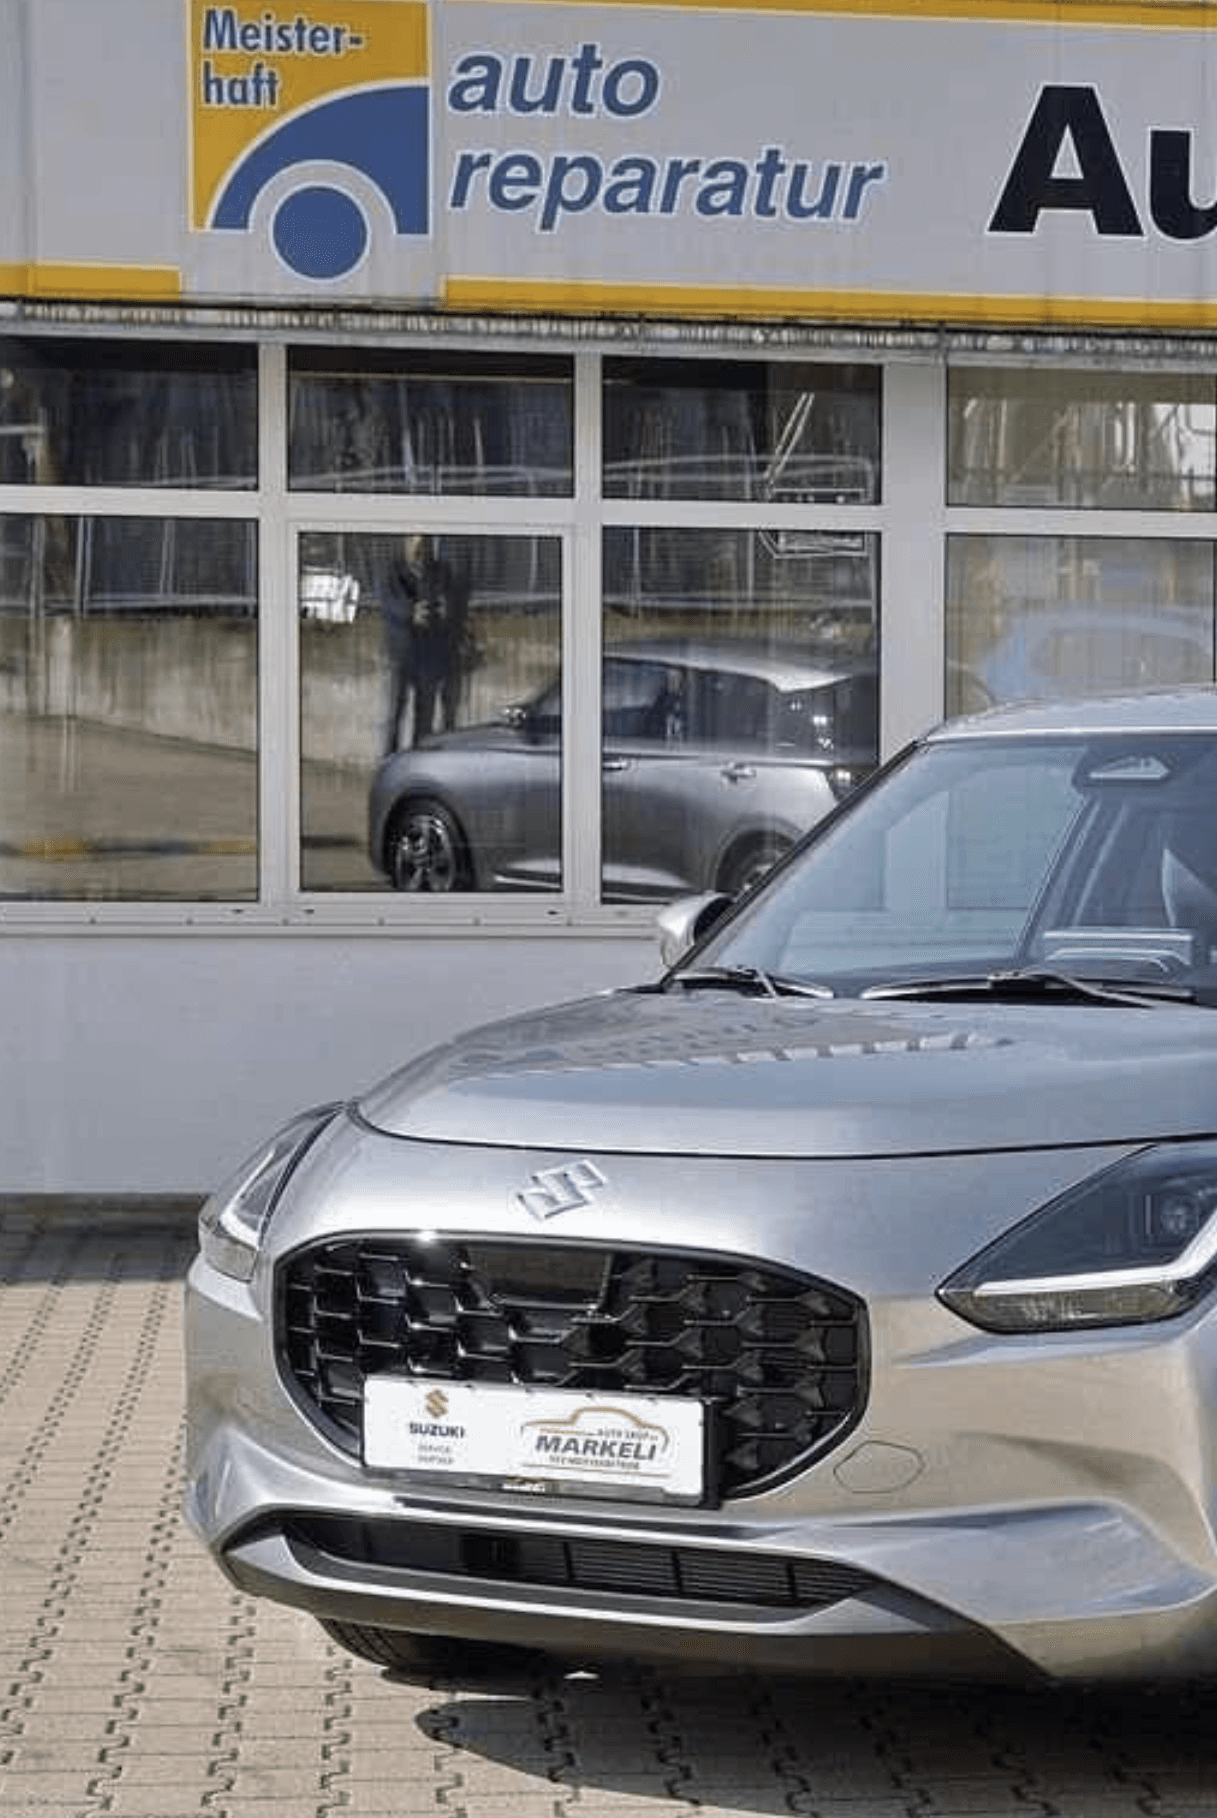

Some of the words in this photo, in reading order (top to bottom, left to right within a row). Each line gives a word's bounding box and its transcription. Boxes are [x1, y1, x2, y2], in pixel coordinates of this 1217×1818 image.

[203, 9, 362, 54] Meister-
[203, 62, 278, 107] haft
[450, 44, 659, 116] auto
[451, 148, 882, 231] reparatur
[409, 1422, 465, 1438] SUZUKI
[535, 1435, 656, 1460] MARKELI
